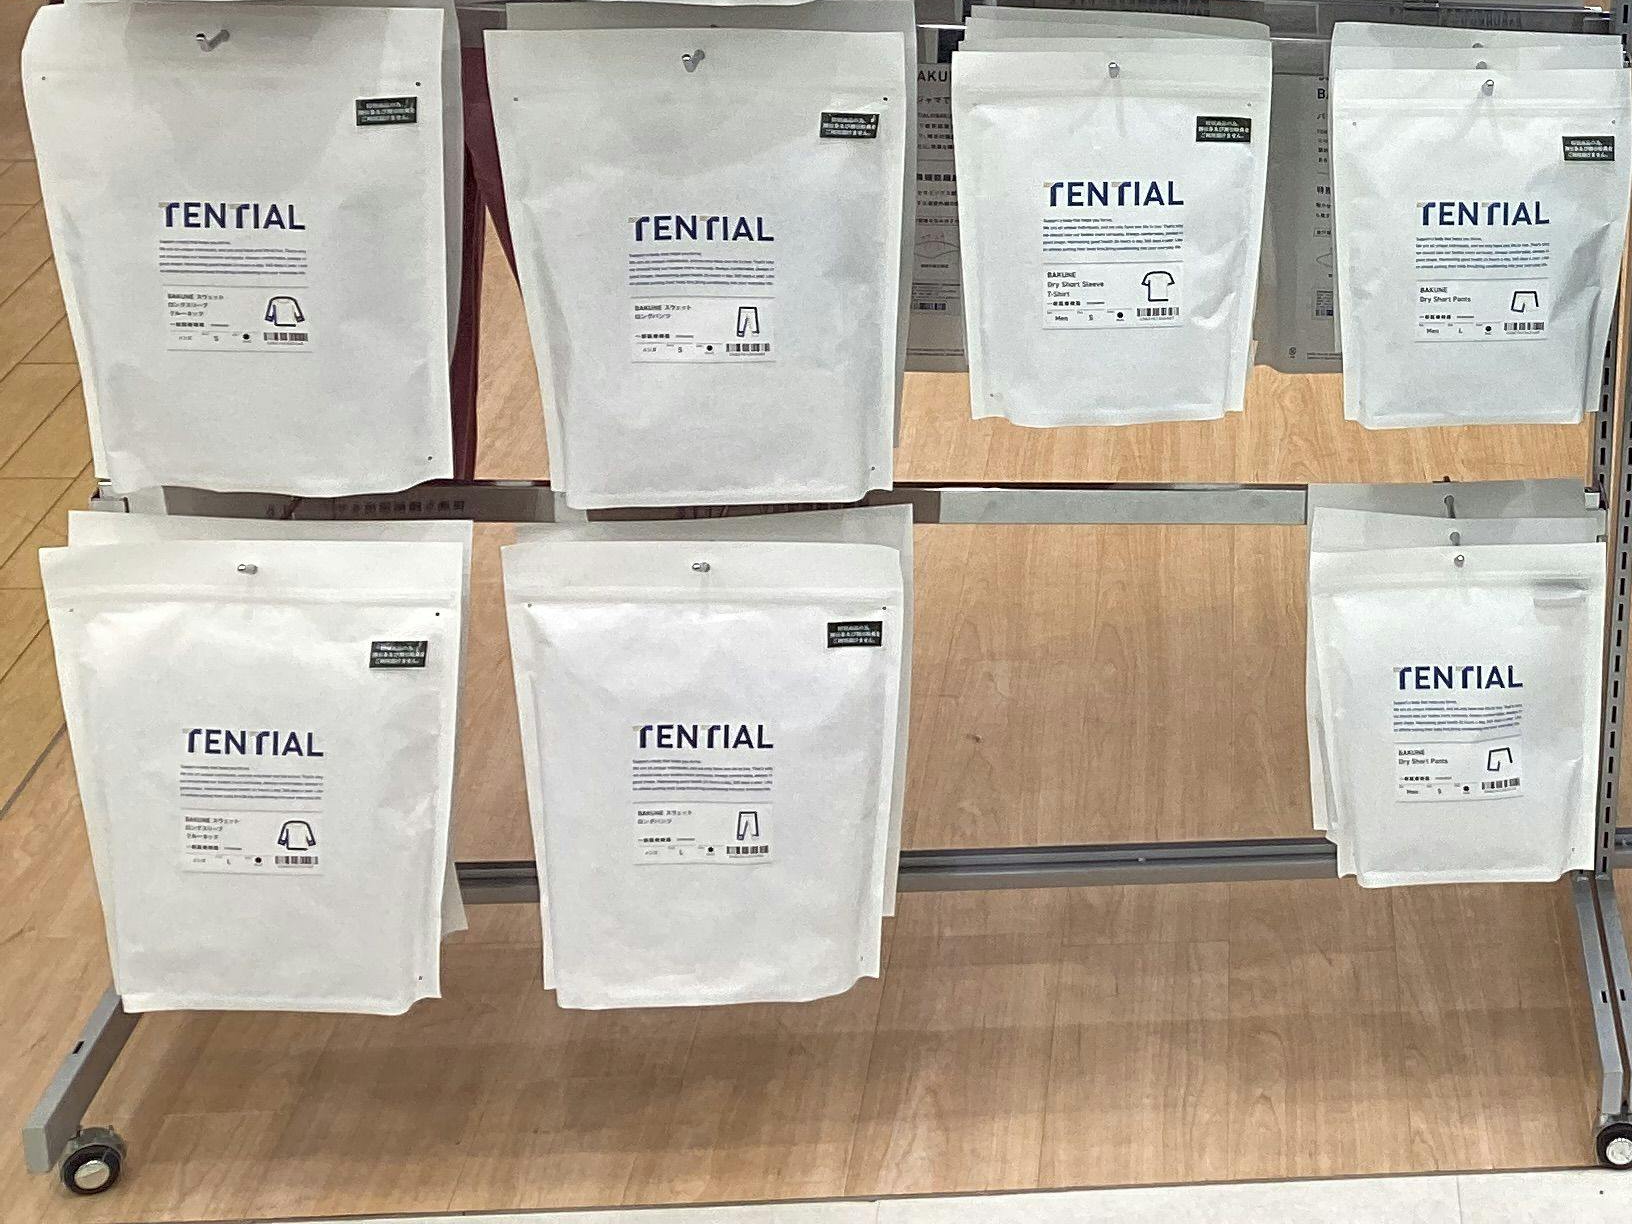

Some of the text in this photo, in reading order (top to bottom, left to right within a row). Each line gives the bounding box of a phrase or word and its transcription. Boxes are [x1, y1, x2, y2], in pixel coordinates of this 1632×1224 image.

[1043, 181, 1184, 207] TENTIAL
[158, 202, 305, 230] TENTIAL
[1416, 201, 1550, 226] TENTIAL
[628, 215, 774, 242] TENTIAL
[1393, 665, 1523, 690] TENTIAL
[182, 728, 324, 757] TENTIAL
[632, 724, 774, 749] TENTIAL
